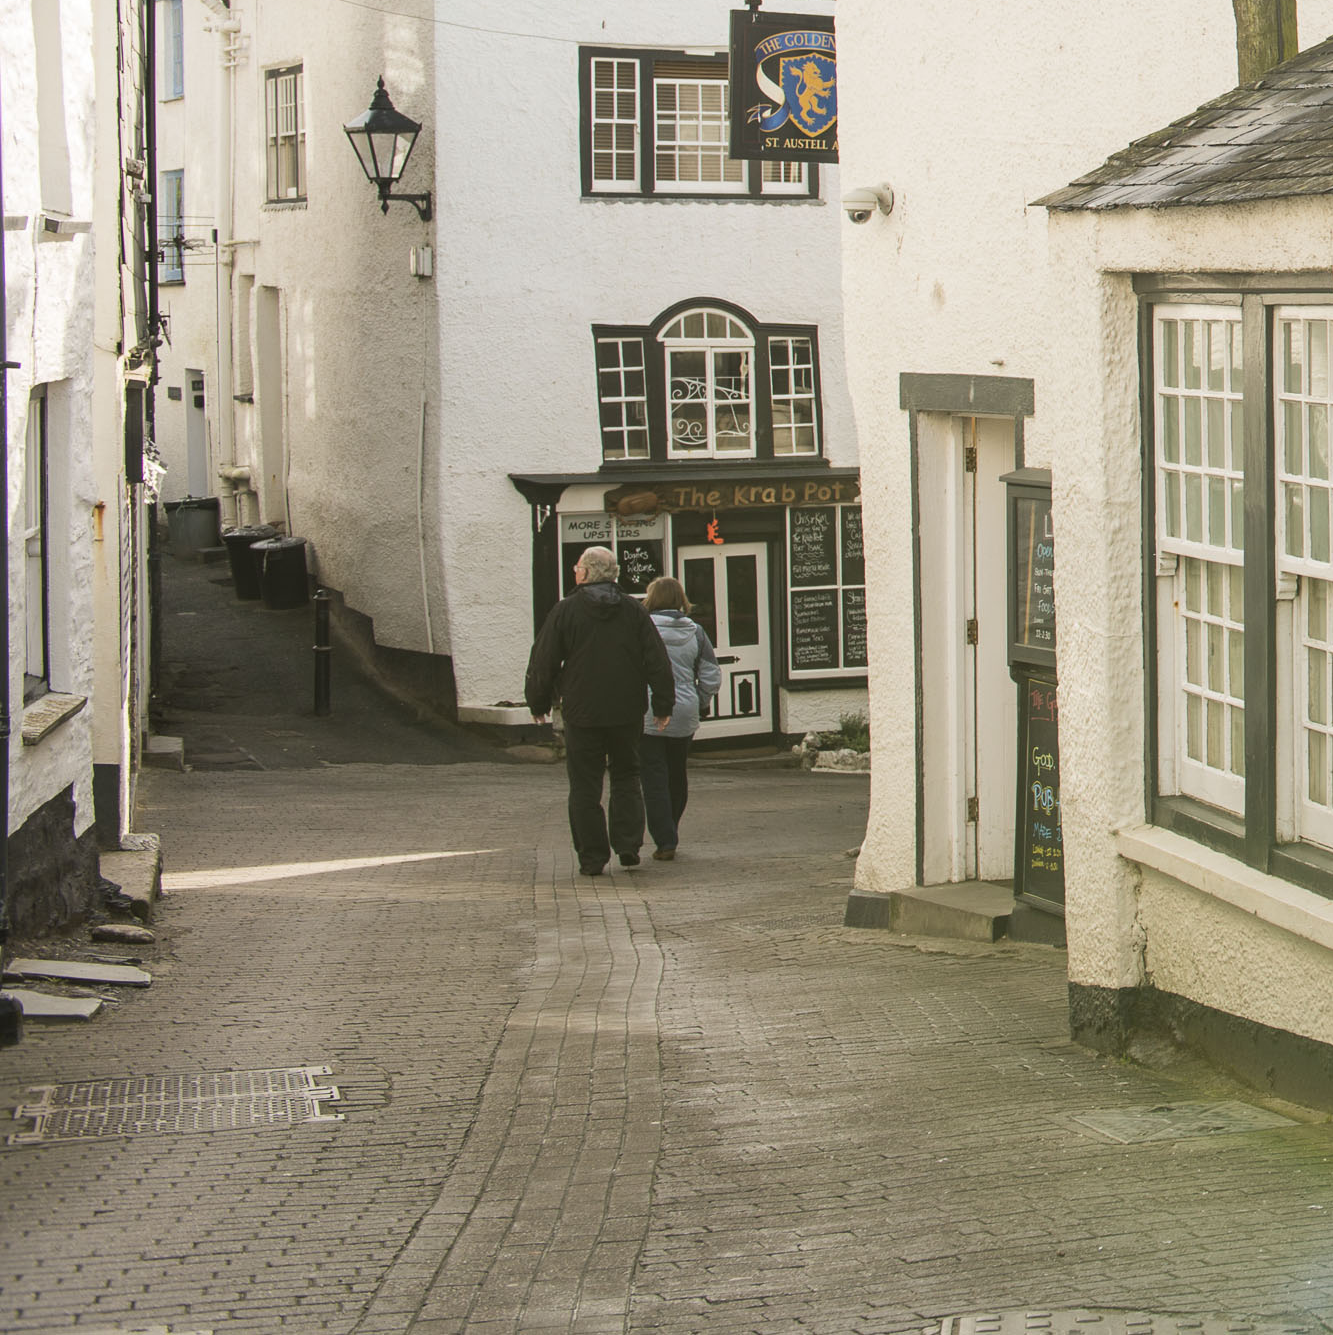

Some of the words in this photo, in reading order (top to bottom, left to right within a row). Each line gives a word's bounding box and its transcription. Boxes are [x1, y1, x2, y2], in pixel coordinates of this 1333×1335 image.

[760, 37, 782, 55] THE
[784, 33, 836, 49] GOLDEN
[783, 138, 828, 150] AUSTELL
[673, 485, 721, 506] The
[734, 483, 796, 506] Krab
[804, 481, 844, 501] Pot
[568, 520, 601, 531] MORE
